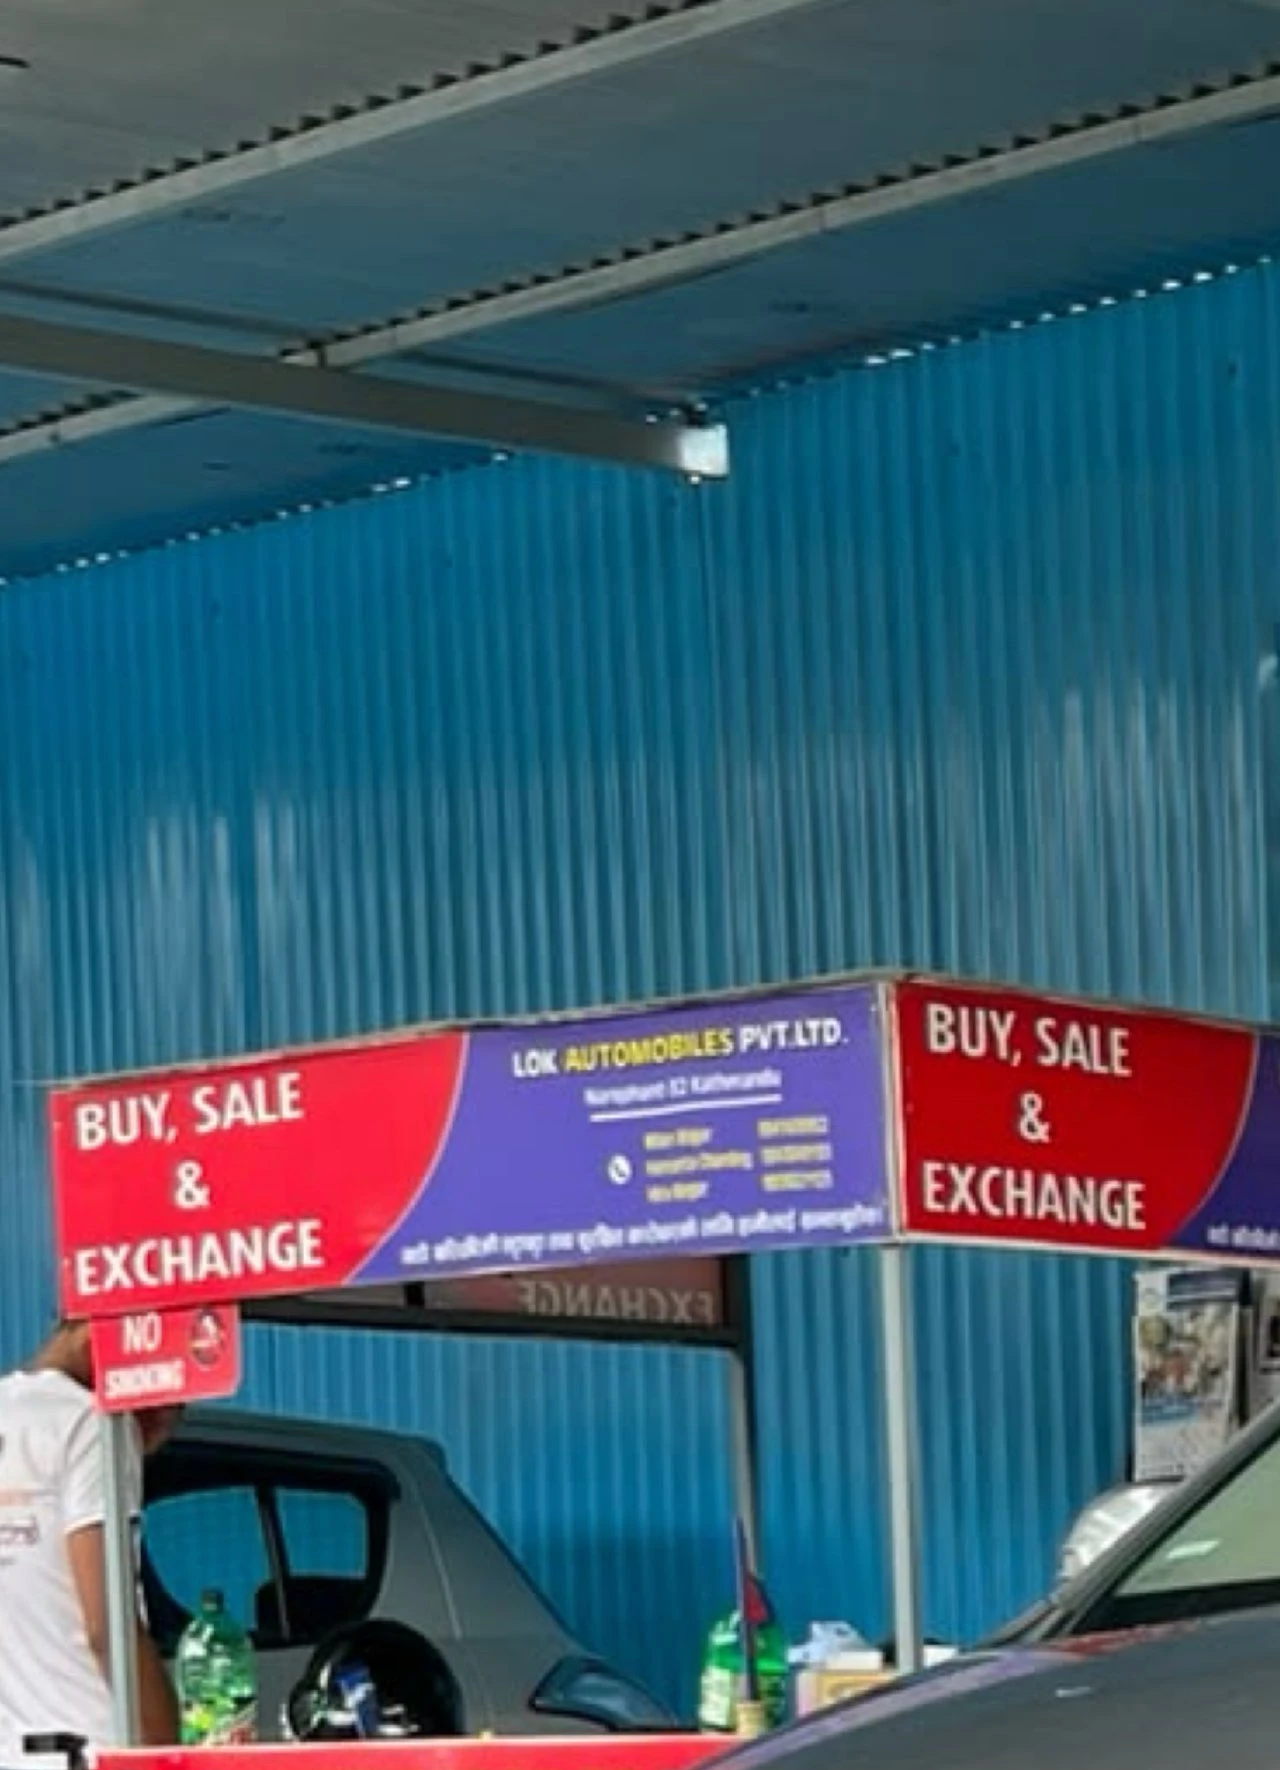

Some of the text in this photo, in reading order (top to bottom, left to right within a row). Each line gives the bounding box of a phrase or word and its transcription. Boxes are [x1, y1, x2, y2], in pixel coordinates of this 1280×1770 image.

[512, 1049, 557, 1078] LOK
[564, 1028, 733, 1072] AUTOMOBILES
[926, 1003, 1132, 1077] BUY, SALE
[74, 1072, 303, 1151] BUY, SALE
[1018, 1093, 1051, 1144] &
[174, 1159, 210, 1210] &
[921, 1161, 1146, 1231] EXCHANGE
[74, 1218, 323, 1296] EXCHANGE
[123, 1311, 162, 1354] NO
